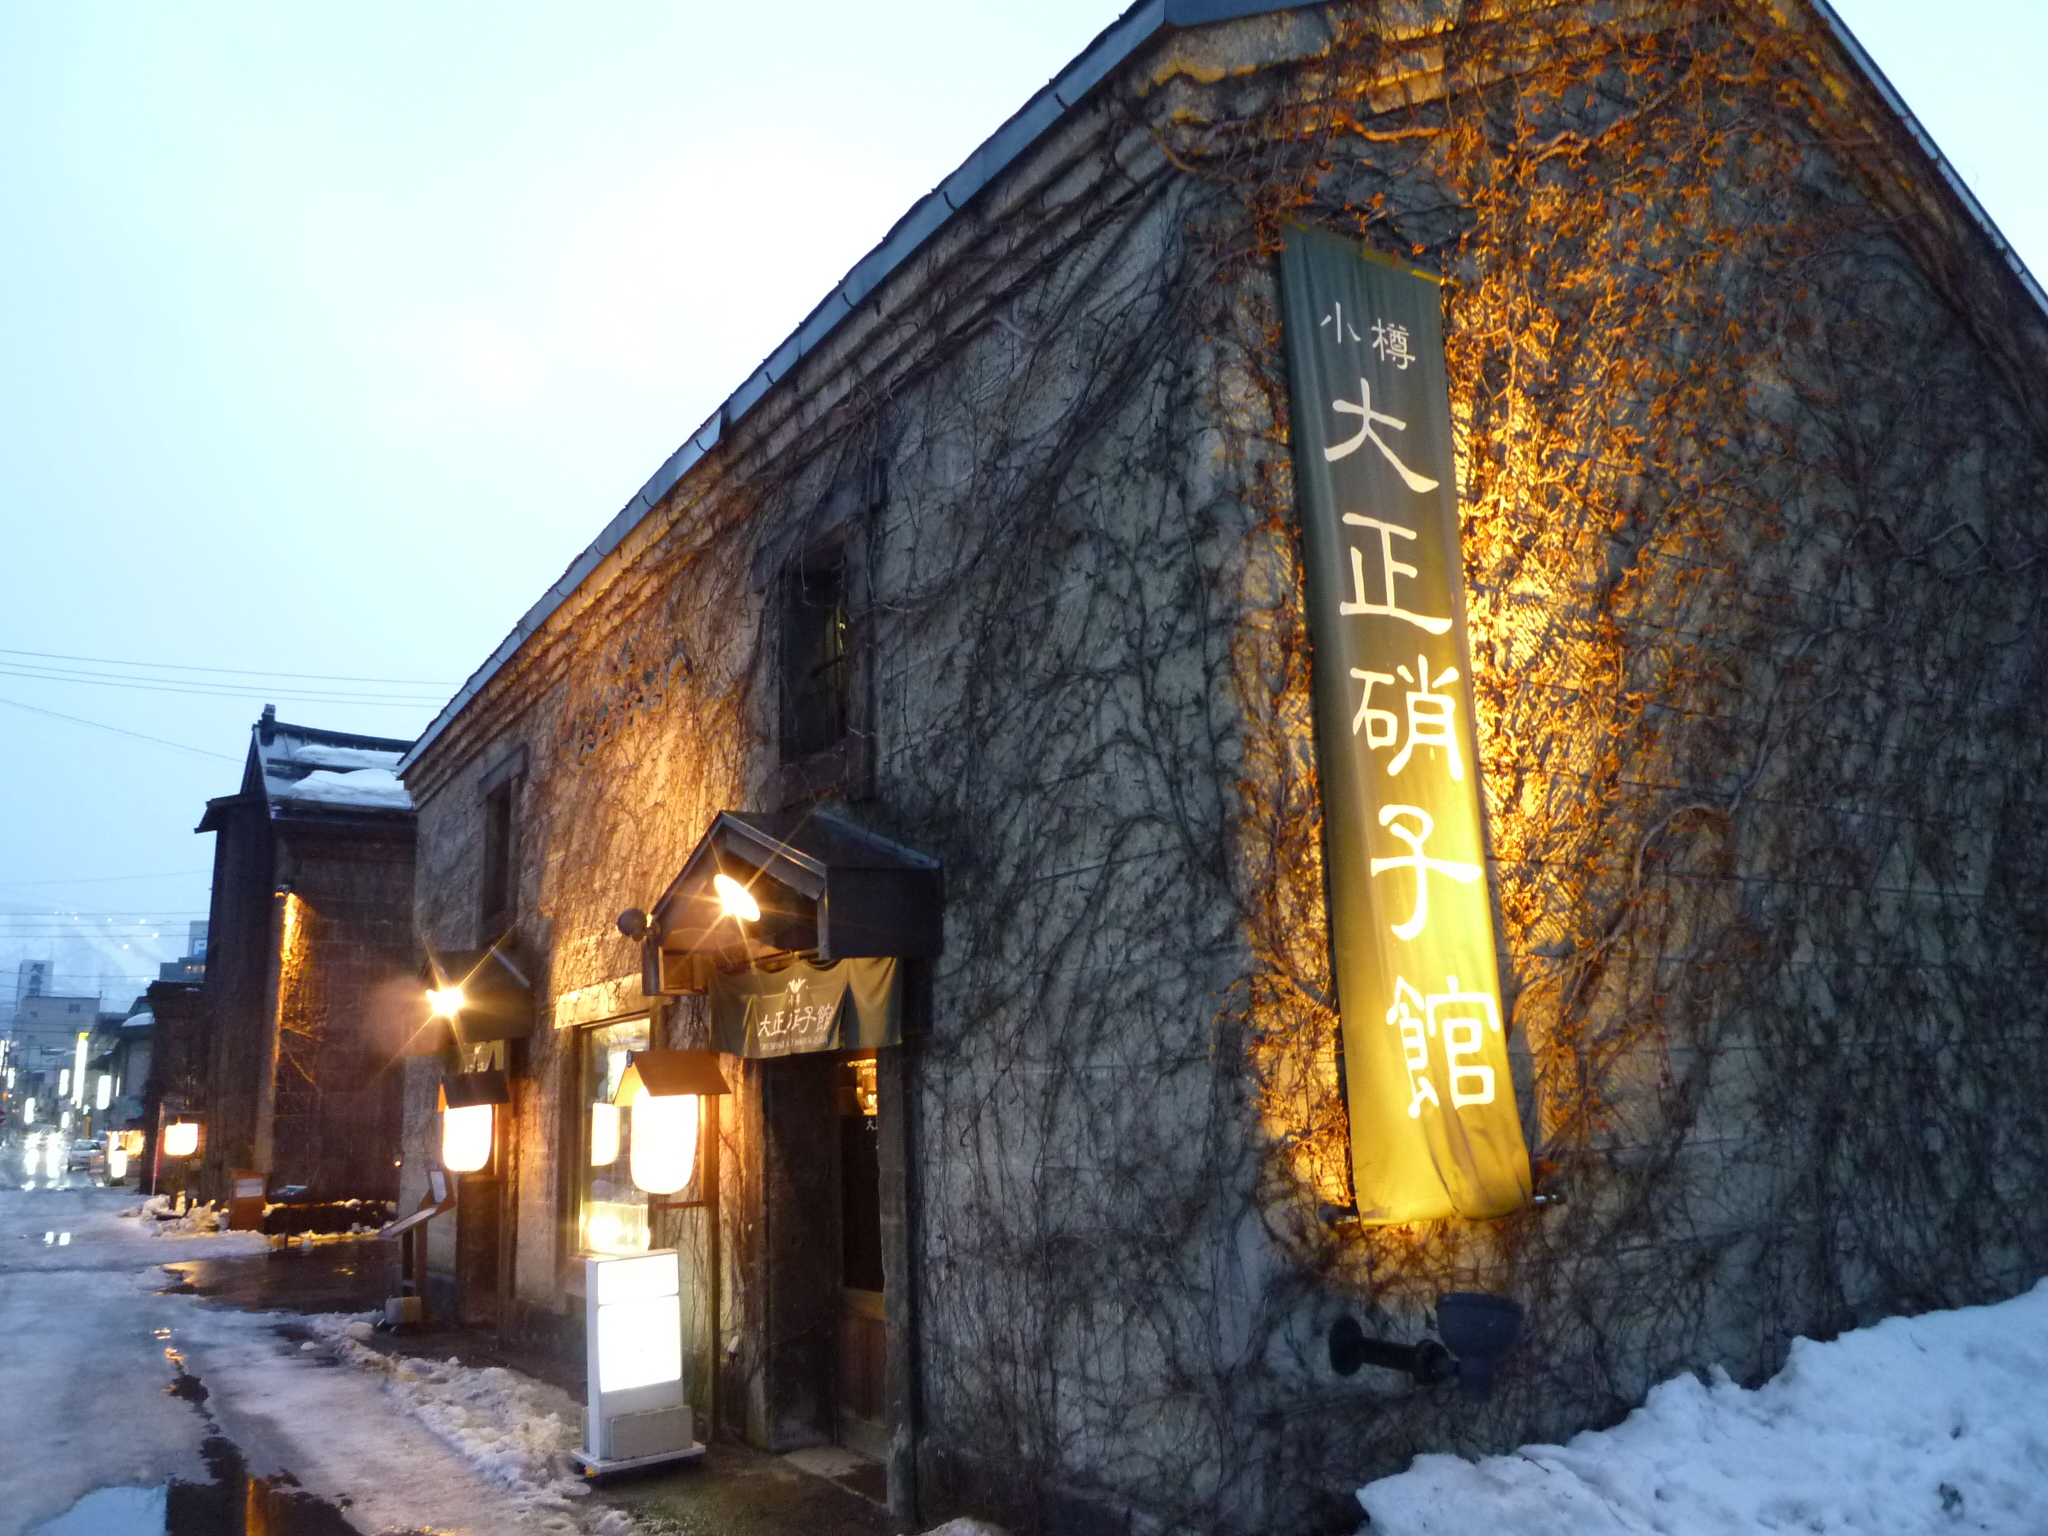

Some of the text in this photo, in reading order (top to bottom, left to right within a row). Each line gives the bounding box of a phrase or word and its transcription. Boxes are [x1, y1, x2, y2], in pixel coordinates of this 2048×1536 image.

[1320, 302, 1415, 370] 小樽
[1324, 378, 1500, 1118] 大正硝子館
